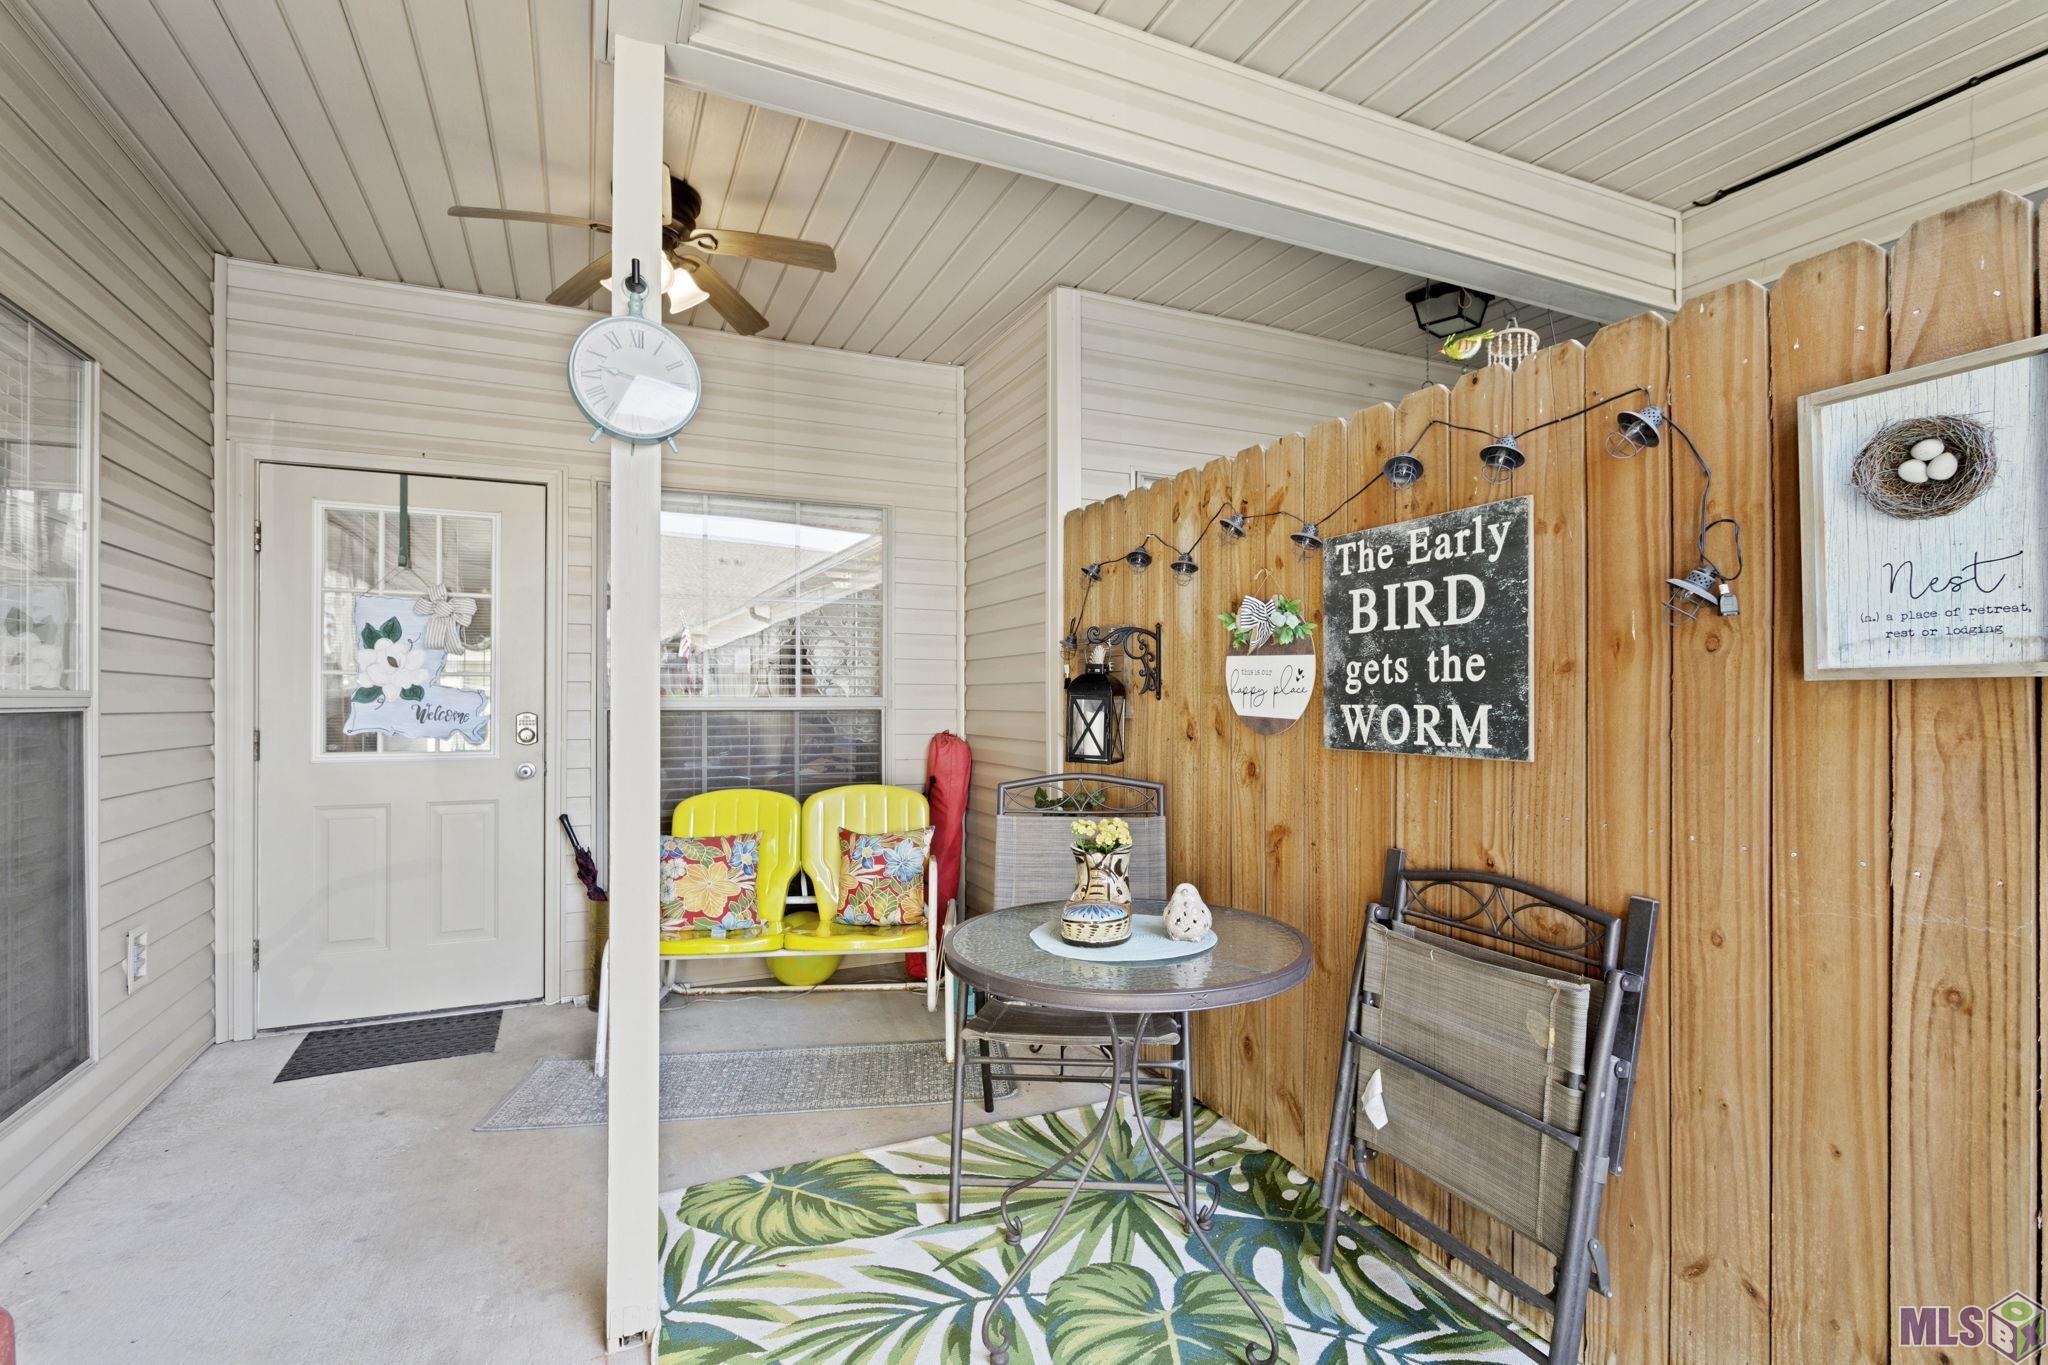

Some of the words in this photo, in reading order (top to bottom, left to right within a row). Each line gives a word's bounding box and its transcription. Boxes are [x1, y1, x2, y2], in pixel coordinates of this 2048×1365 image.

[1336, 539, 1394, 576] The
[1407, 515, 1511, 566] Early
[1883, 550, 2023, 599] Nest
[1348, 573, 1486, 635] BIRD
[1860, 611, 1880, 623] (n.)
[1885, 613, 1894, 621] a
[1900, 610, 1938, 622] place
[1944, 607, 1961, 618] of
[1968, 602, 2032, 616] retreat,
[1885, 628, 1915, 639] rest
[1921, 628, 1938, 637] or
[1945, 624, 2004, 636] lodging
[1231, 668, 1267, 709] happy
[1273, 664, 1308, 709] place
[1345, 653, 1409, 695] gets
[1427, 644, 1487, 683] the
[411, 703, 470, 724] Welcome
[1340, 703, 1493, 749] WORM
